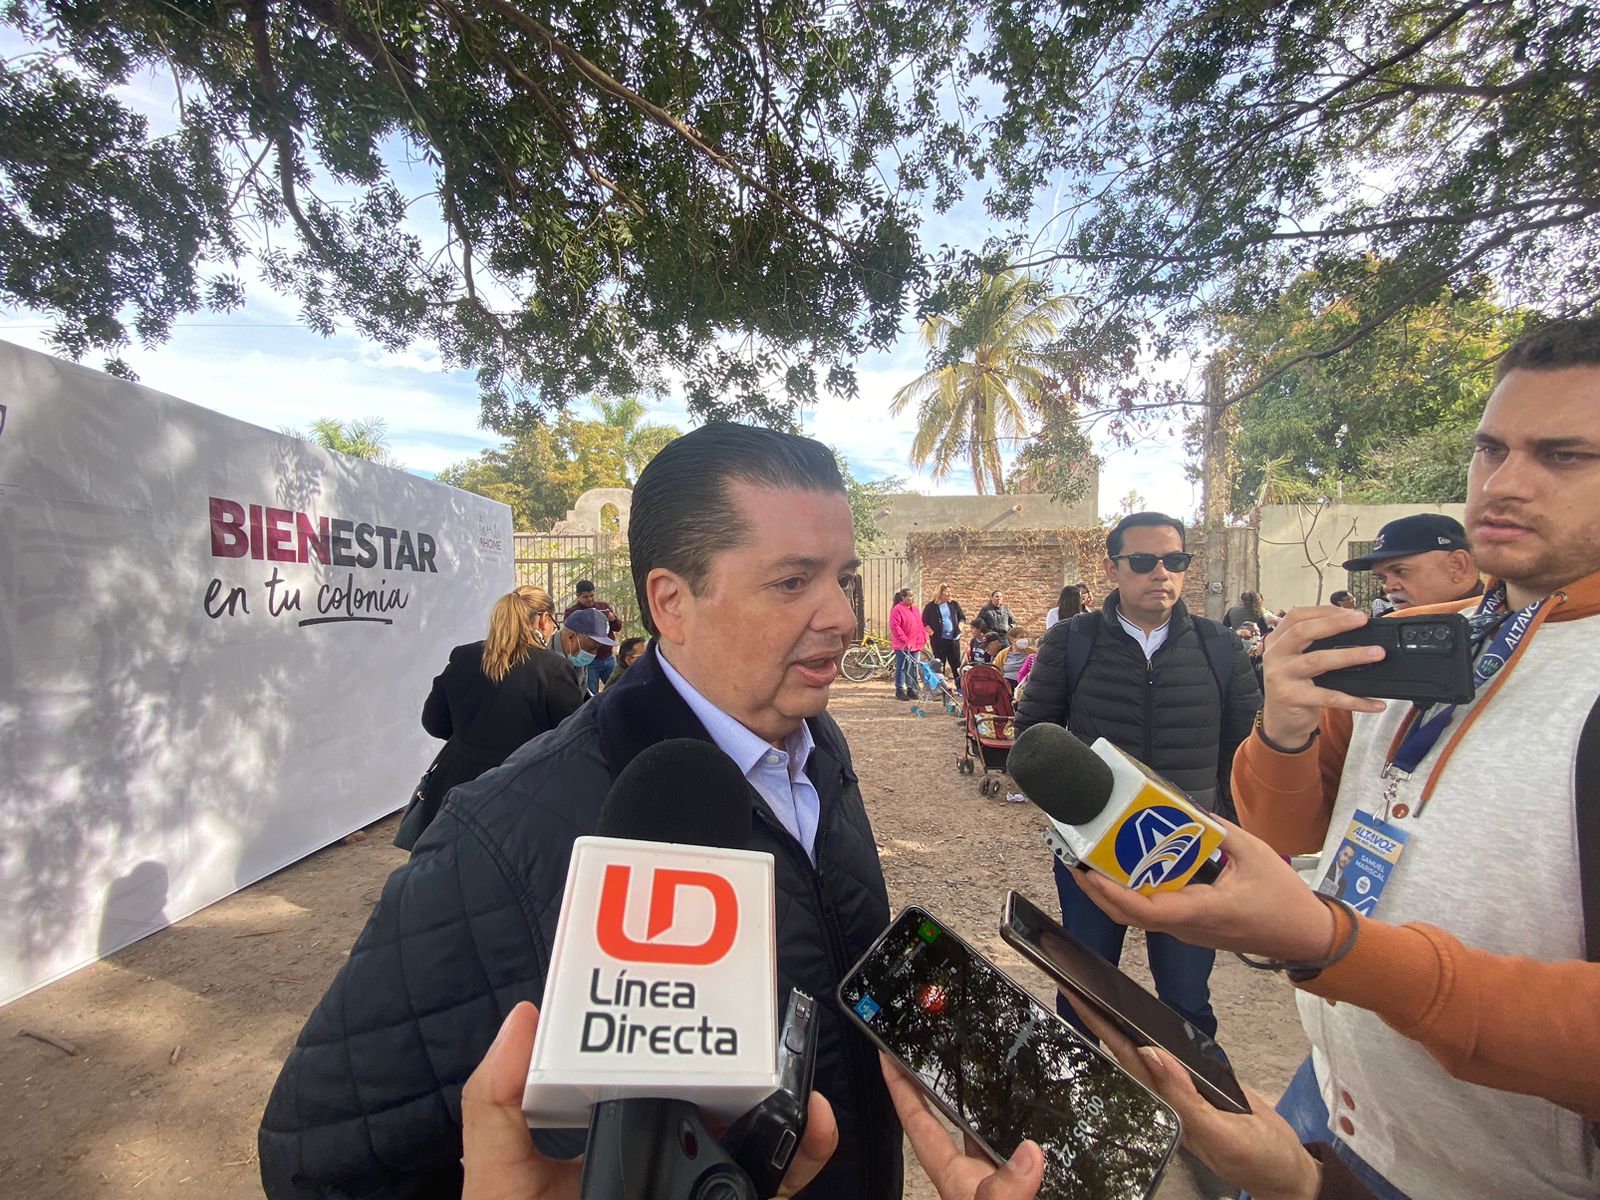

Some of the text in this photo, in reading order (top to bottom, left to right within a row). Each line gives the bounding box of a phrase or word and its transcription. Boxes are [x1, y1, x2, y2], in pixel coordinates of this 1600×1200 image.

[209, 496, 438, 573] BIENESTAR
[204, 567, 409, 618] en tu colonia
[1504, 596, 1545, 650] ALTAVO
[1353, 827, 1396, 853] ALTAVOZ
[1354, 859, 1386, 882] MARISCAL
[1360, 854, 1385, 873] SAMUEL
[590, 967, 696, 1010] Línea
[580, 1011, 738, 1056] Directa
